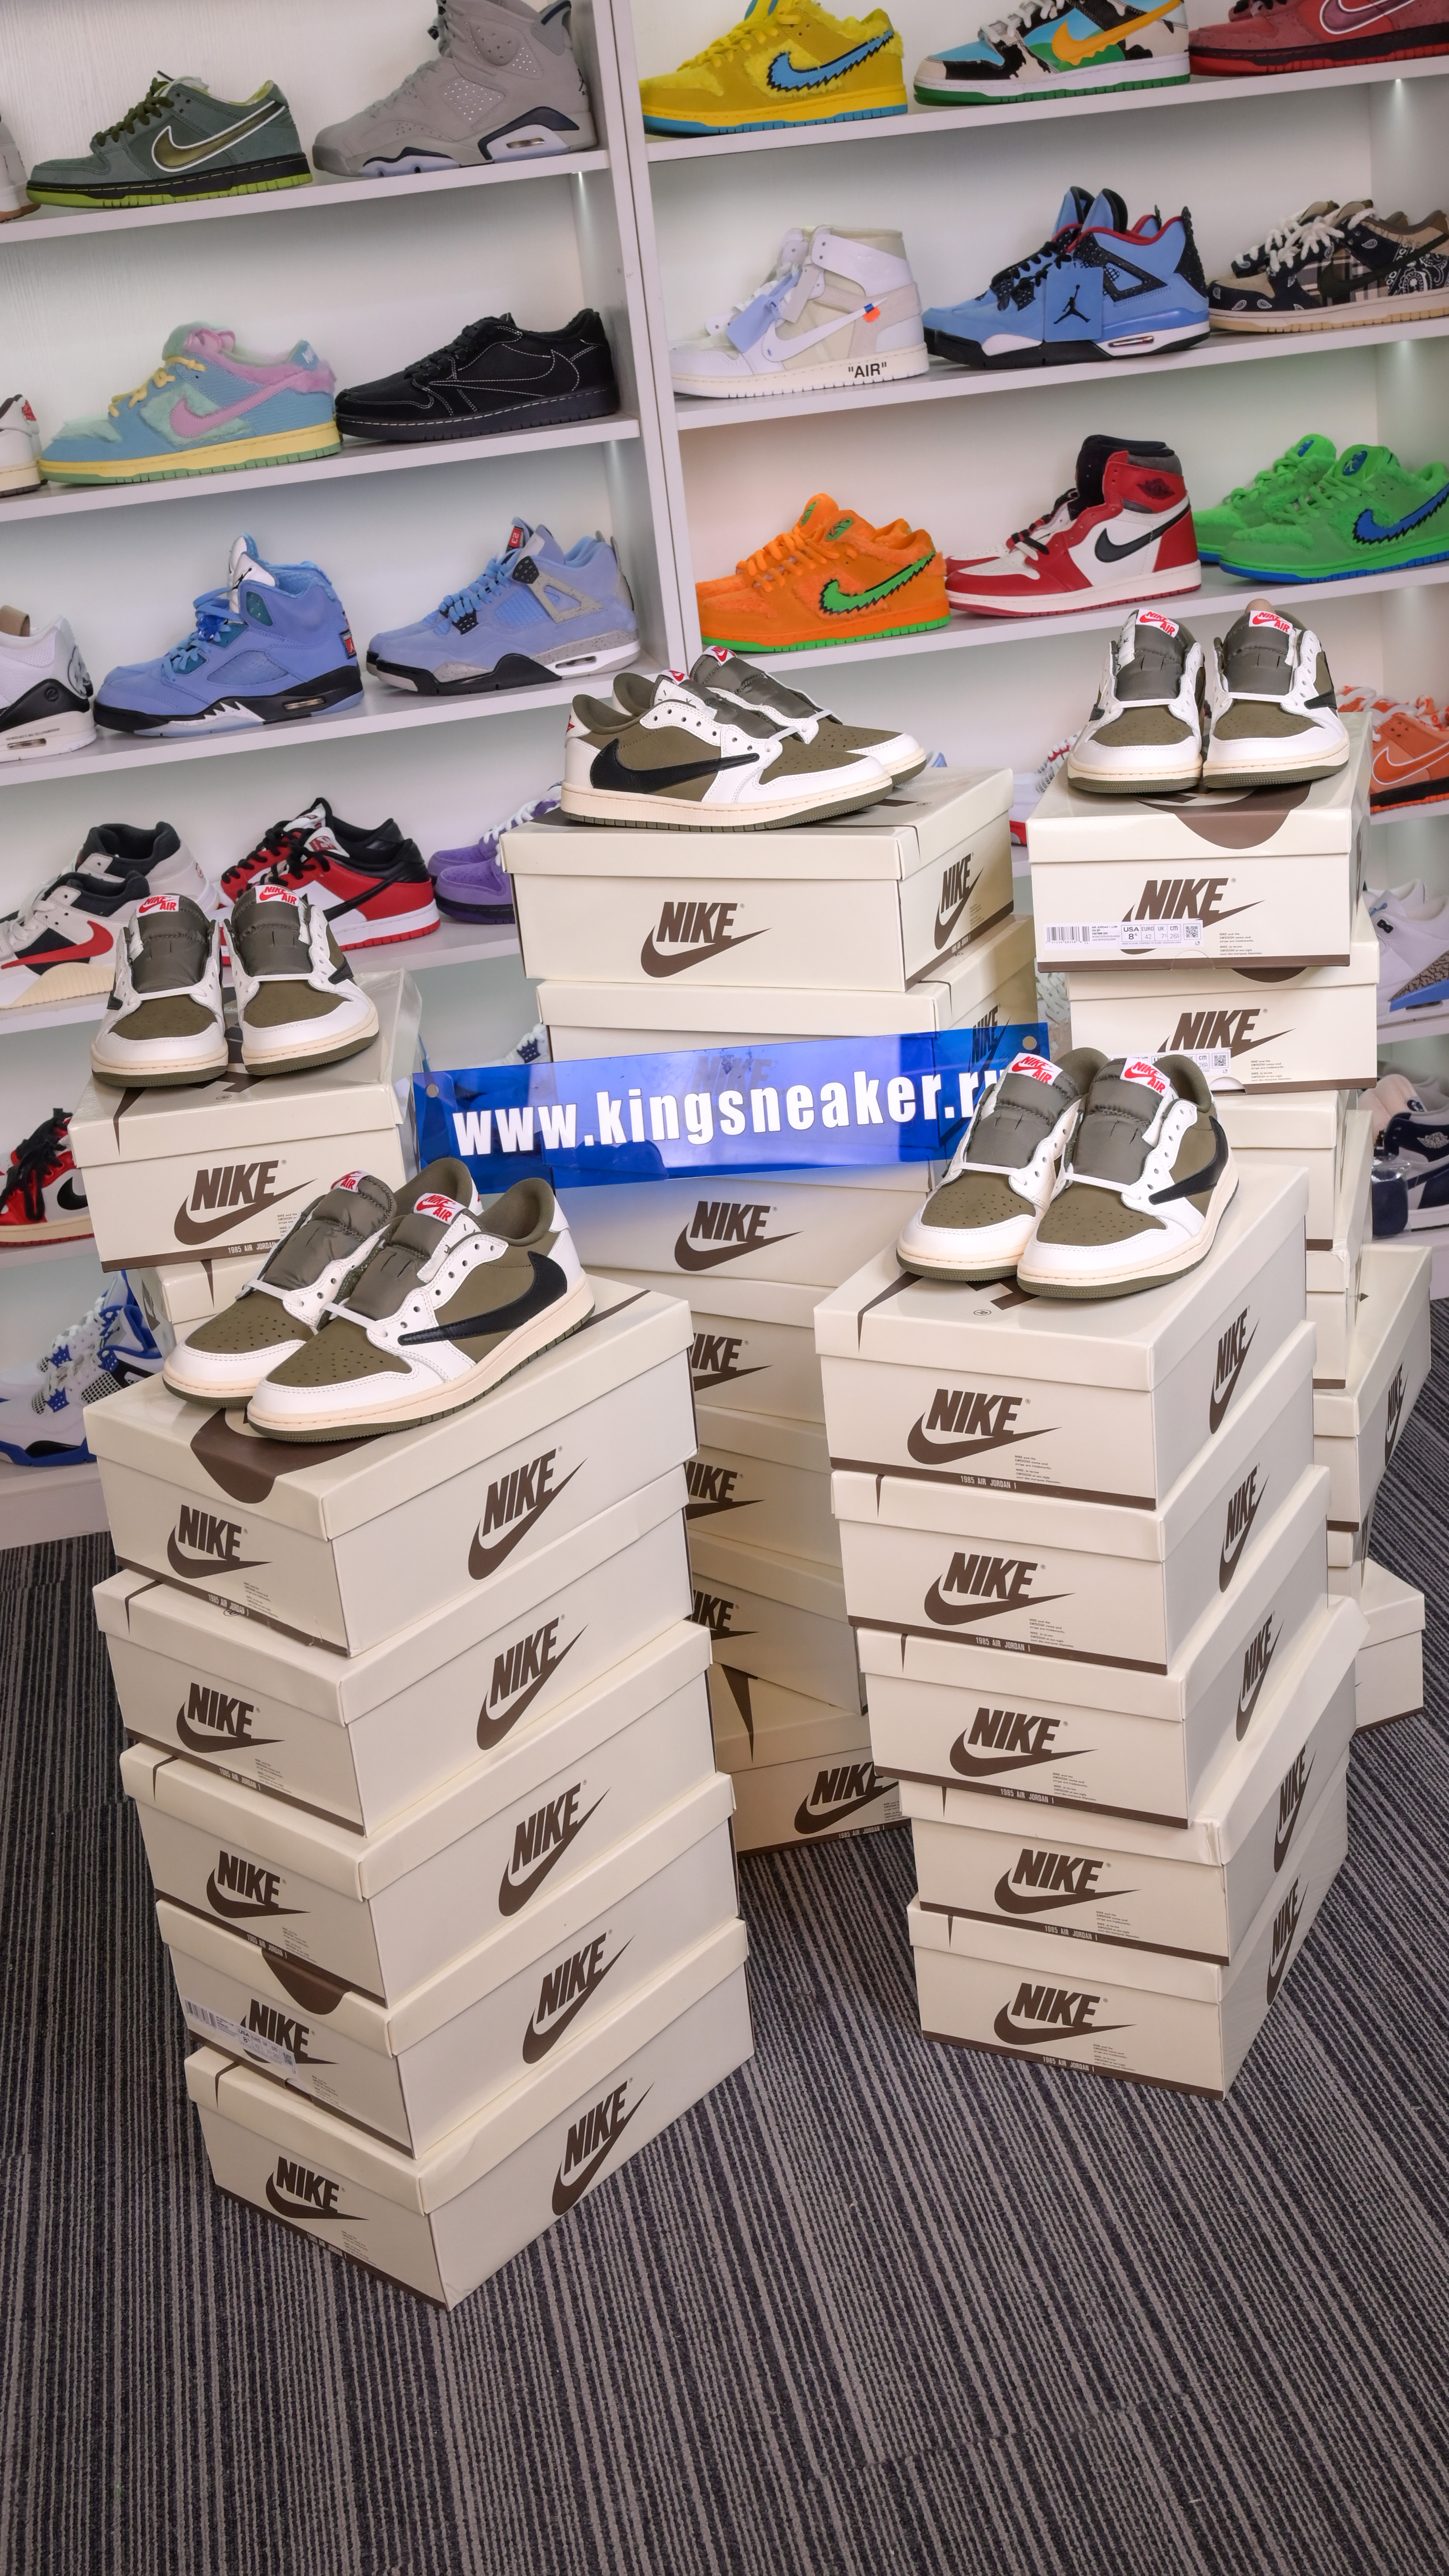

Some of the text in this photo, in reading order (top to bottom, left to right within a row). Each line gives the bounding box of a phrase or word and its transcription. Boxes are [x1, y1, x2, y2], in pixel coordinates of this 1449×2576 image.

[848, 361, 887, 378] "AIR"
[1146, 611, 1168, 621] NIKE
[1160, 621, 1175, 635] AIR
[1274, 620, 1290, 632] AIR
[144, 896, 167, 905] NIKE
[264, 886, 285, 894] NIKE
[282, 894, 297, 905] AIR
[941, 853, 972, 914] NIKE
[1135, 878, 1228, 920] NIKE
[160, 902, 177, 910] AIR
[655, 902, 737, 944] NIKE
[1171, 1009, 1260, 1050] NIKE
[1021, 1056, 1048, 1070] NIKE
[1032, 1070, 1052, 1083] AIR
[1132, 1061, 1159, 1075] NIKE
[1147, 1077, 1165, 1093] AIR
[191, 1160, 277, 1211] NIKE
[341, 1179, 356, 1190] AIR
[424, 1194, 452, 1206] NIKE
[433, 1207, 452, 1221] AIR
[690, 1201, 770, 1242] NIKE
[691, 1333, 742, 1372] IKE
[1215, 1308, 1248, 1391] NIKE
[926, 1390, 1022, 1437] NIKE
[1387, 1363, 1402, 1431] NIKE
[482, 1449, 556, 1536] NIKE
[961, 1476, 974, 1484] 1985
[990, 1479, 1010, 1488] JORDAN
[1225, 1465, 1258, 1550] NIKE
[178, 1505, 241, 1561] NIKE
[943, 1552, 1037, 1599] NIKE
[693, 1590, 733, 1631] IKE
[490, 1618, 558, 1708] NIKE
[1005, 1641, 1025, 1650] JORDAN
[1242, 1614, 1272, 1697] NIKE
[188, 1683, 254, 1738] NIKE
[968, 1708, 1060, 1755] NIKE
[1000, 1789, 1014, 1797] 1985
[1029, 1794, 1048, 1803] JORDAN
[1280, 1745, 1306, 1830] NIKE
[513, 1783, 581, 1874] NIKE
[217, 1850, 280, 1908] NIKE
[1012, 1849, 1103, 1893] NIKE
[1072, 1931, 1092, 1940] JORDAN
[1272, 1881, 1299, 1957] NIKE
[537, 1932, 606, 2023] NIKE
[1011, 1983, 1100, 2027] NIKE
[249, 1999, 309, 2057] NIKE
[1070, 2062, 1089, 2071] JORDAN
[564, 2081, 627, 2174] NIKE
[277, 2157, 339, 2211] NIKE
